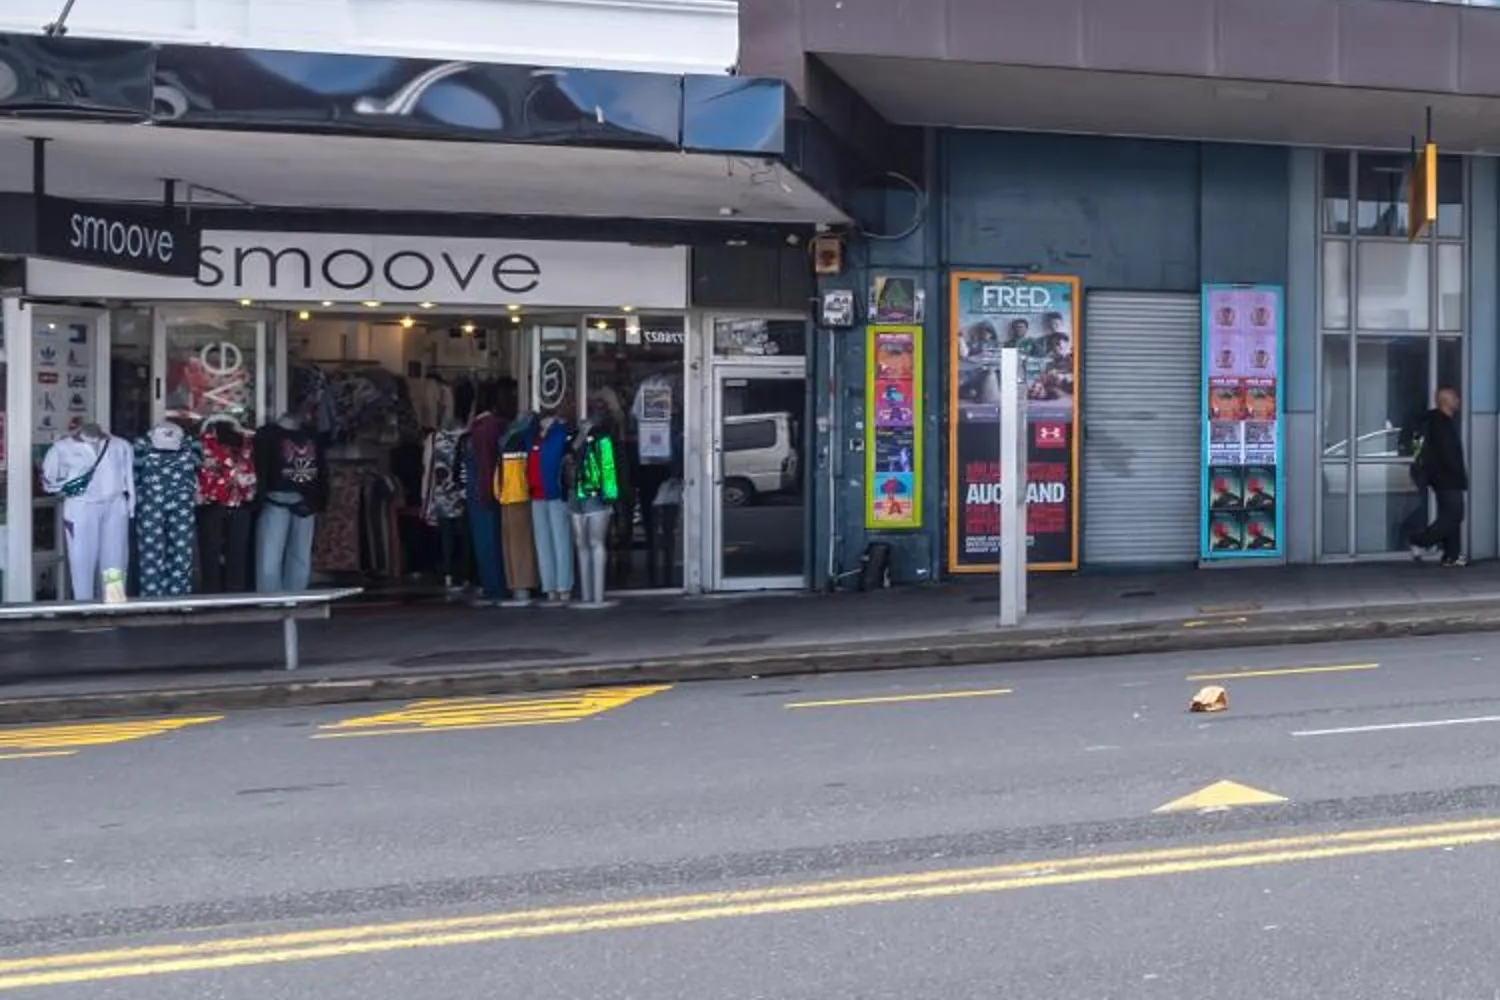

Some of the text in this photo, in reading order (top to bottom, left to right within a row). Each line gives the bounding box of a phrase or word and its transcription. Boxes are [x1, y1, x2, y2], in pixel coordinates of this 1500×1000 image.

[70, 212, 174, 263] smoove
[194, 245, 541, 294] smoove
[965, 482, 1066, 505] AUCAND
